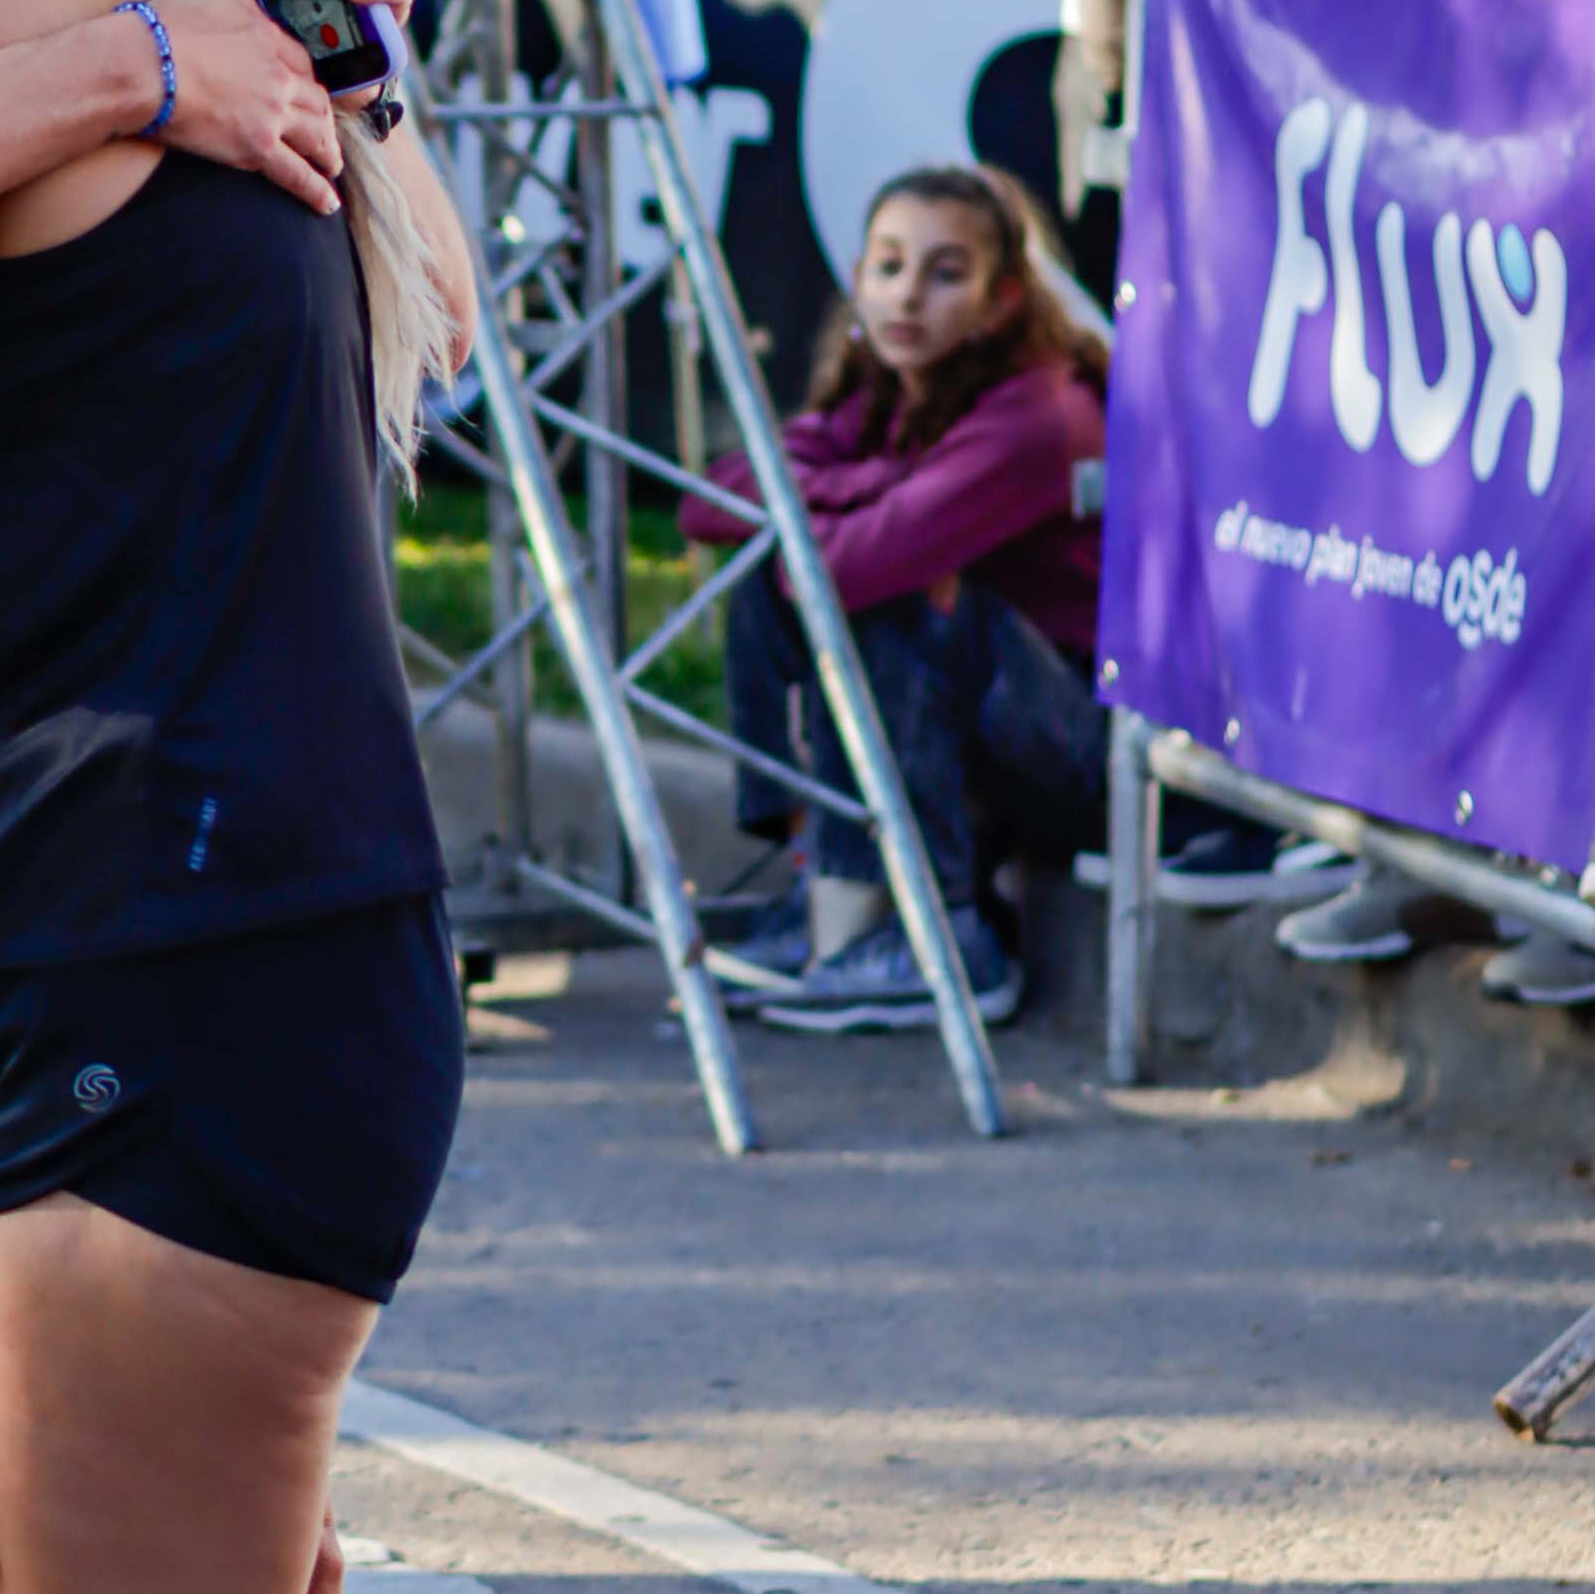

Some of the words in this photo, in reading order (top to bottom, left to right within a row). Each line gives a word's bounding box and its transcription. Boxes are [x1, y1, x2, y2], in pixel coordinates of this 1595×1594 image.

[1214, 500, 1248, 551] el
[1241, 514, 1312, 571] nuevo
[1305, 523, 1358, 587] plan
[1351, 534, 1414, 601] joven
[1413, 549, 1442, 609] de
[1443, 546, 1527, 649] osde
